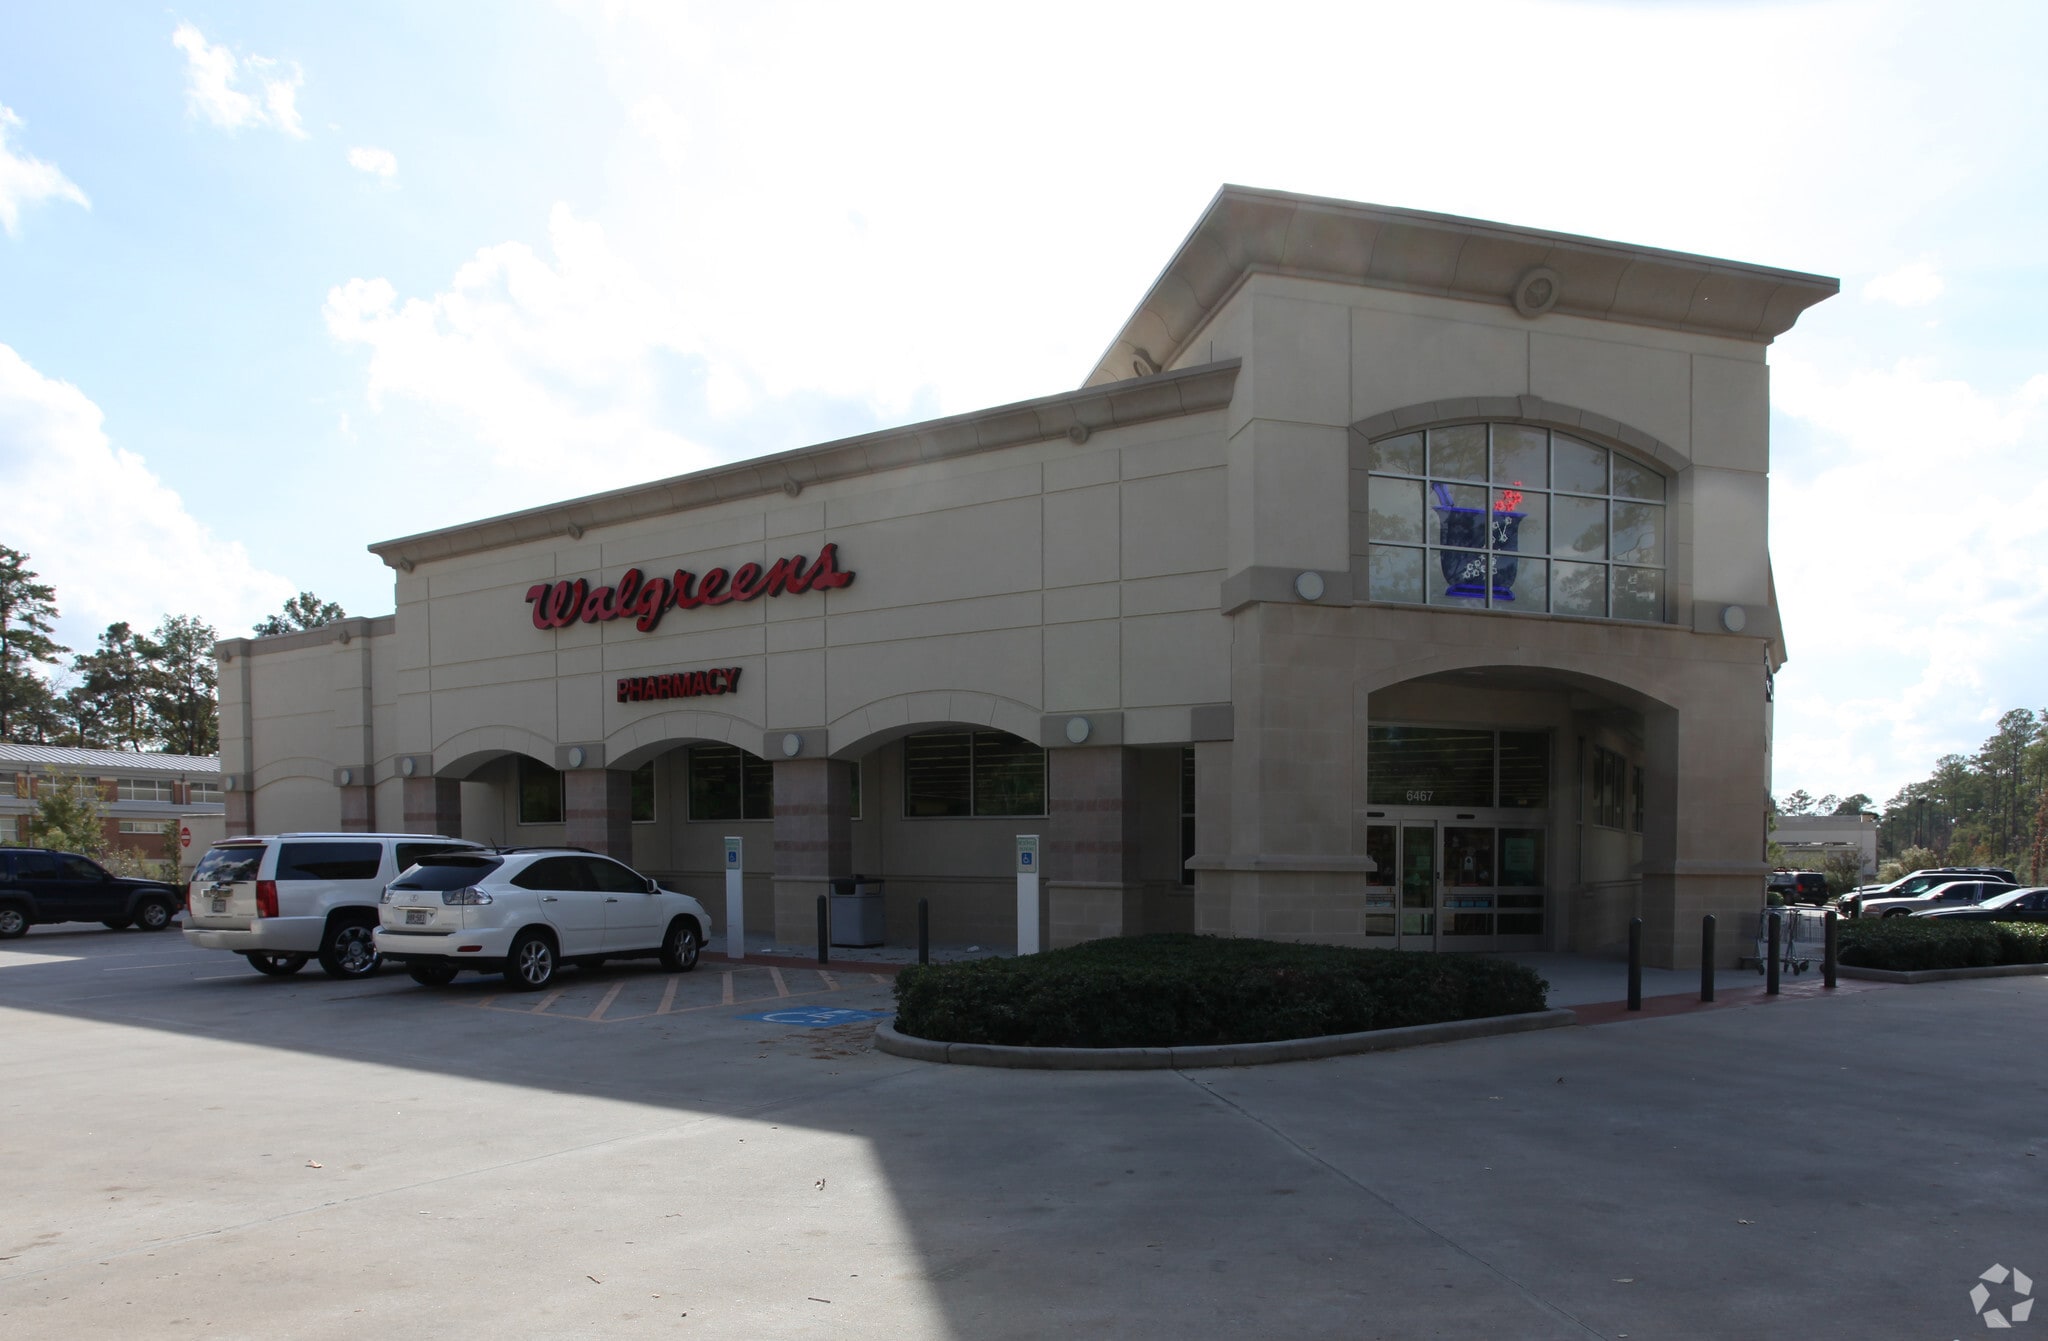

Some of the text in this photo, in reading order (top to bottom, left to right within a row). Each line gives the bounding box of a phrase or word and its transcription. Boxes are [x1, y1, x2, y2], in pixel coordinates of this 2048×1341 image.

[525, 542, 856, 632] Walgreens
[616, 667, 742, 703] PHARMACY
[1406, 790, 1434, 802] 6467
